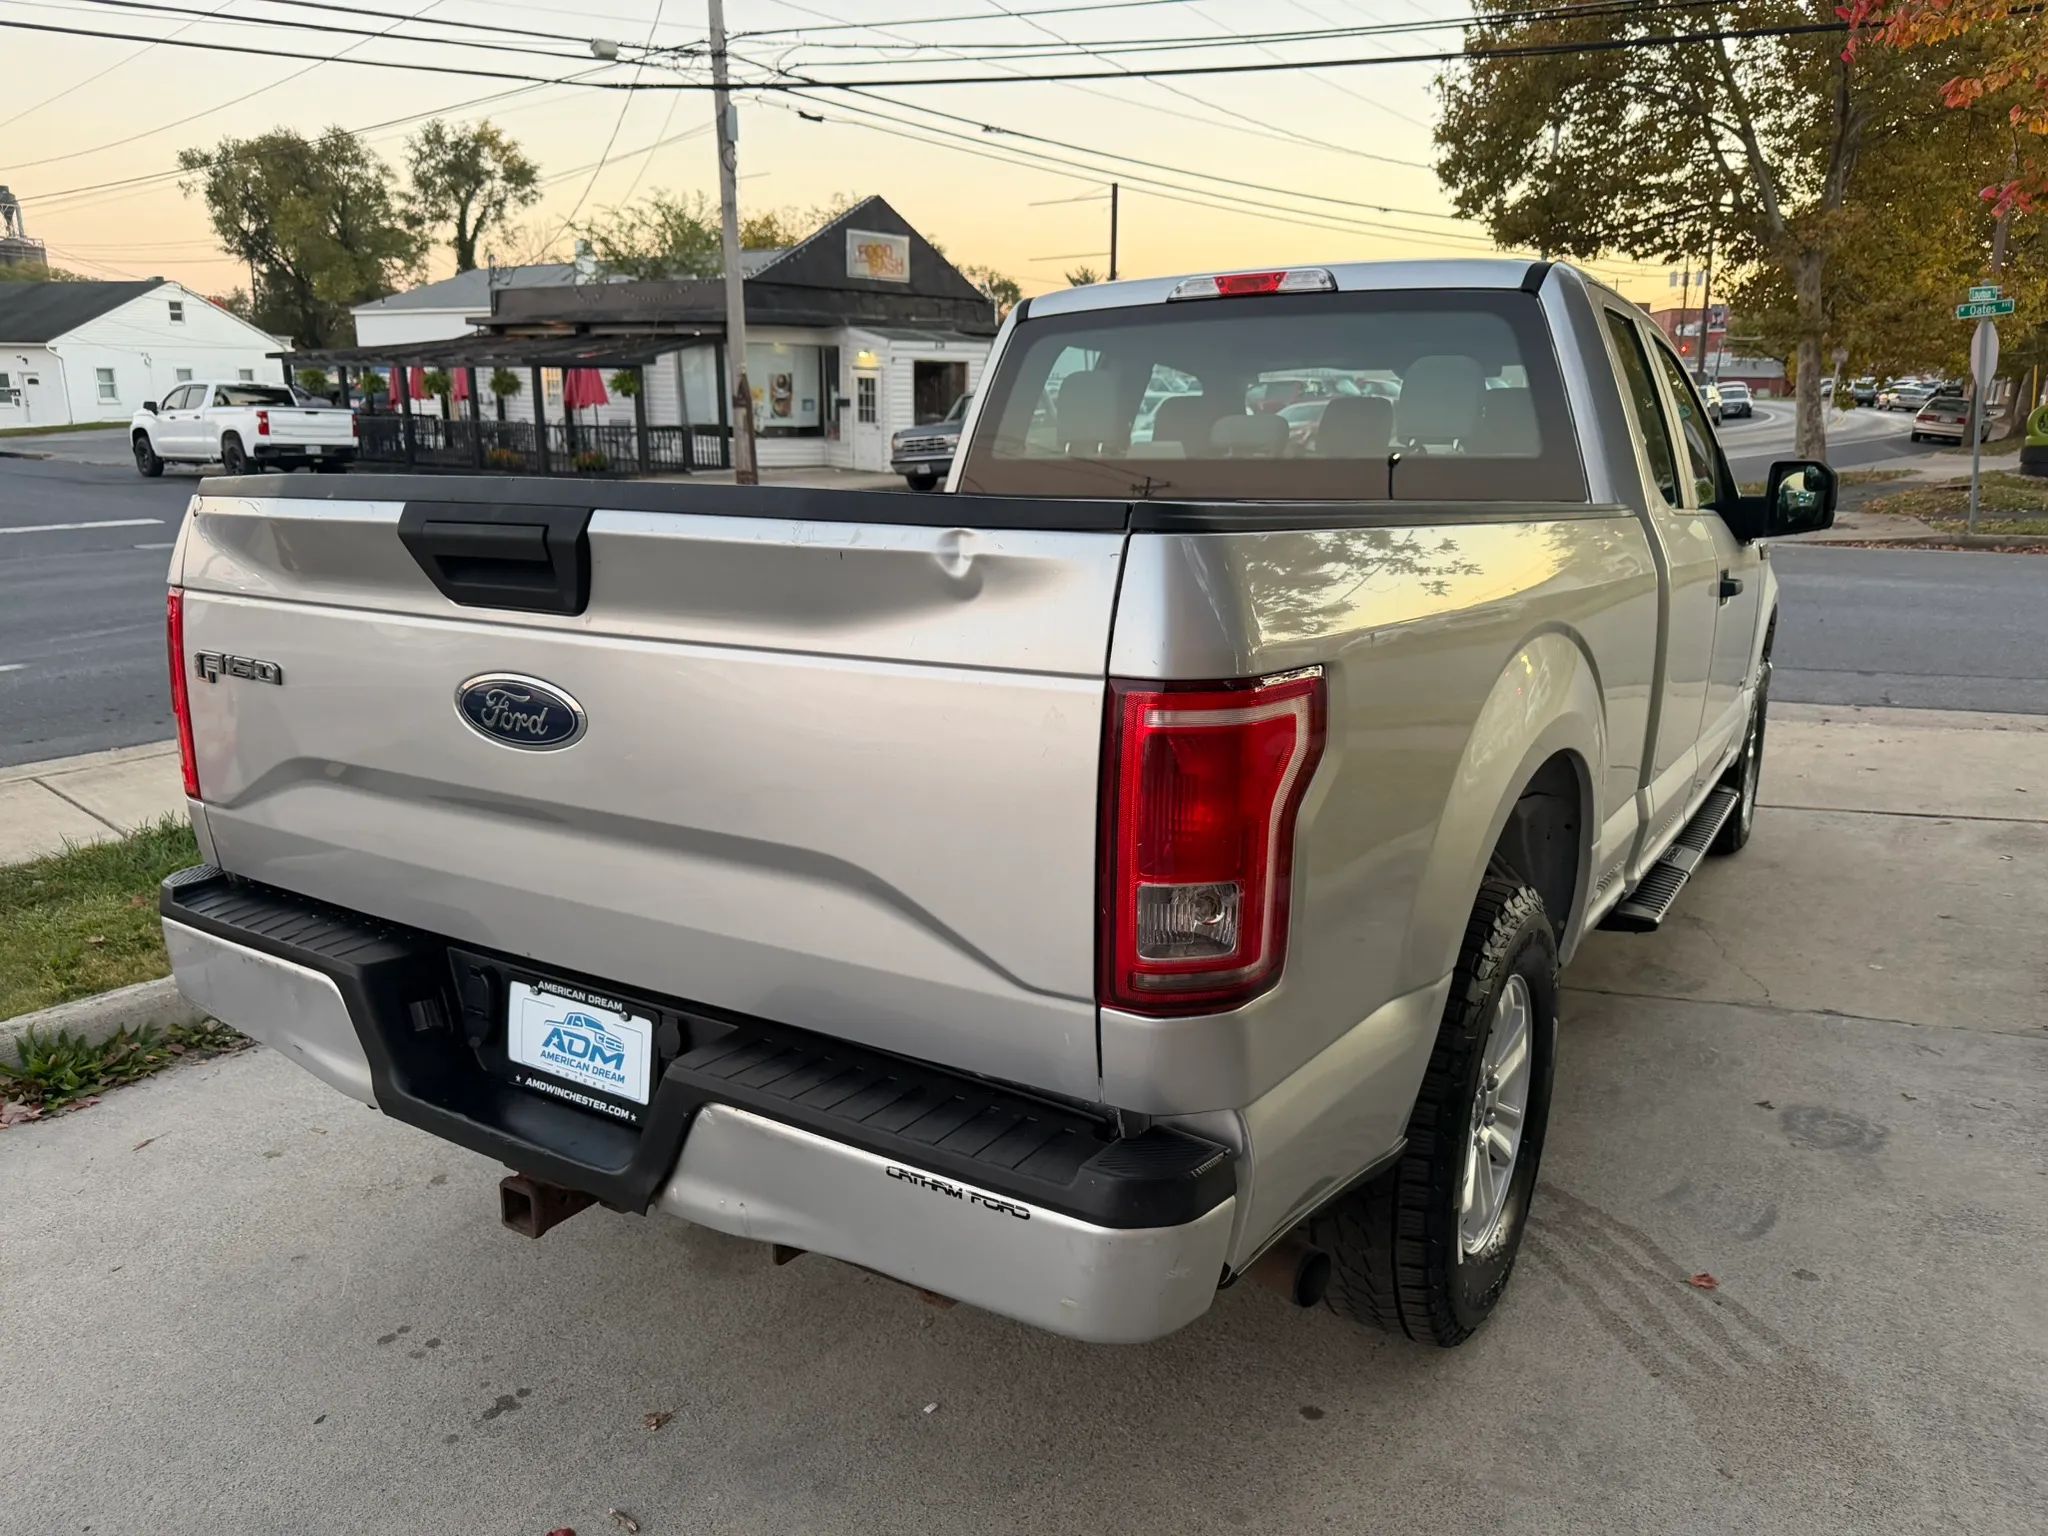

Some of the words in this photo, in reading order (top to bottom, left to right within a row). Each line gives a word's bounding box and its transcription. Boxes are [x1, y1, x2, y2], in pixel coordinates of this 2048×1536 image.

[1969, 305, 1996, 316] Oates
[481, 688, 549, 736] Ford
[538, 980, 586, 1002] AMERICAN
[587, 994, 623, 1012] DREAM
[540, 1050, 592, 1073] AMERICAN
[592, 1066, 626, 1084] DREAM
[542, 1027, 626, 1071] ADM
[525, 1077, 630, 1119] AMDWINCHESTER.COM
